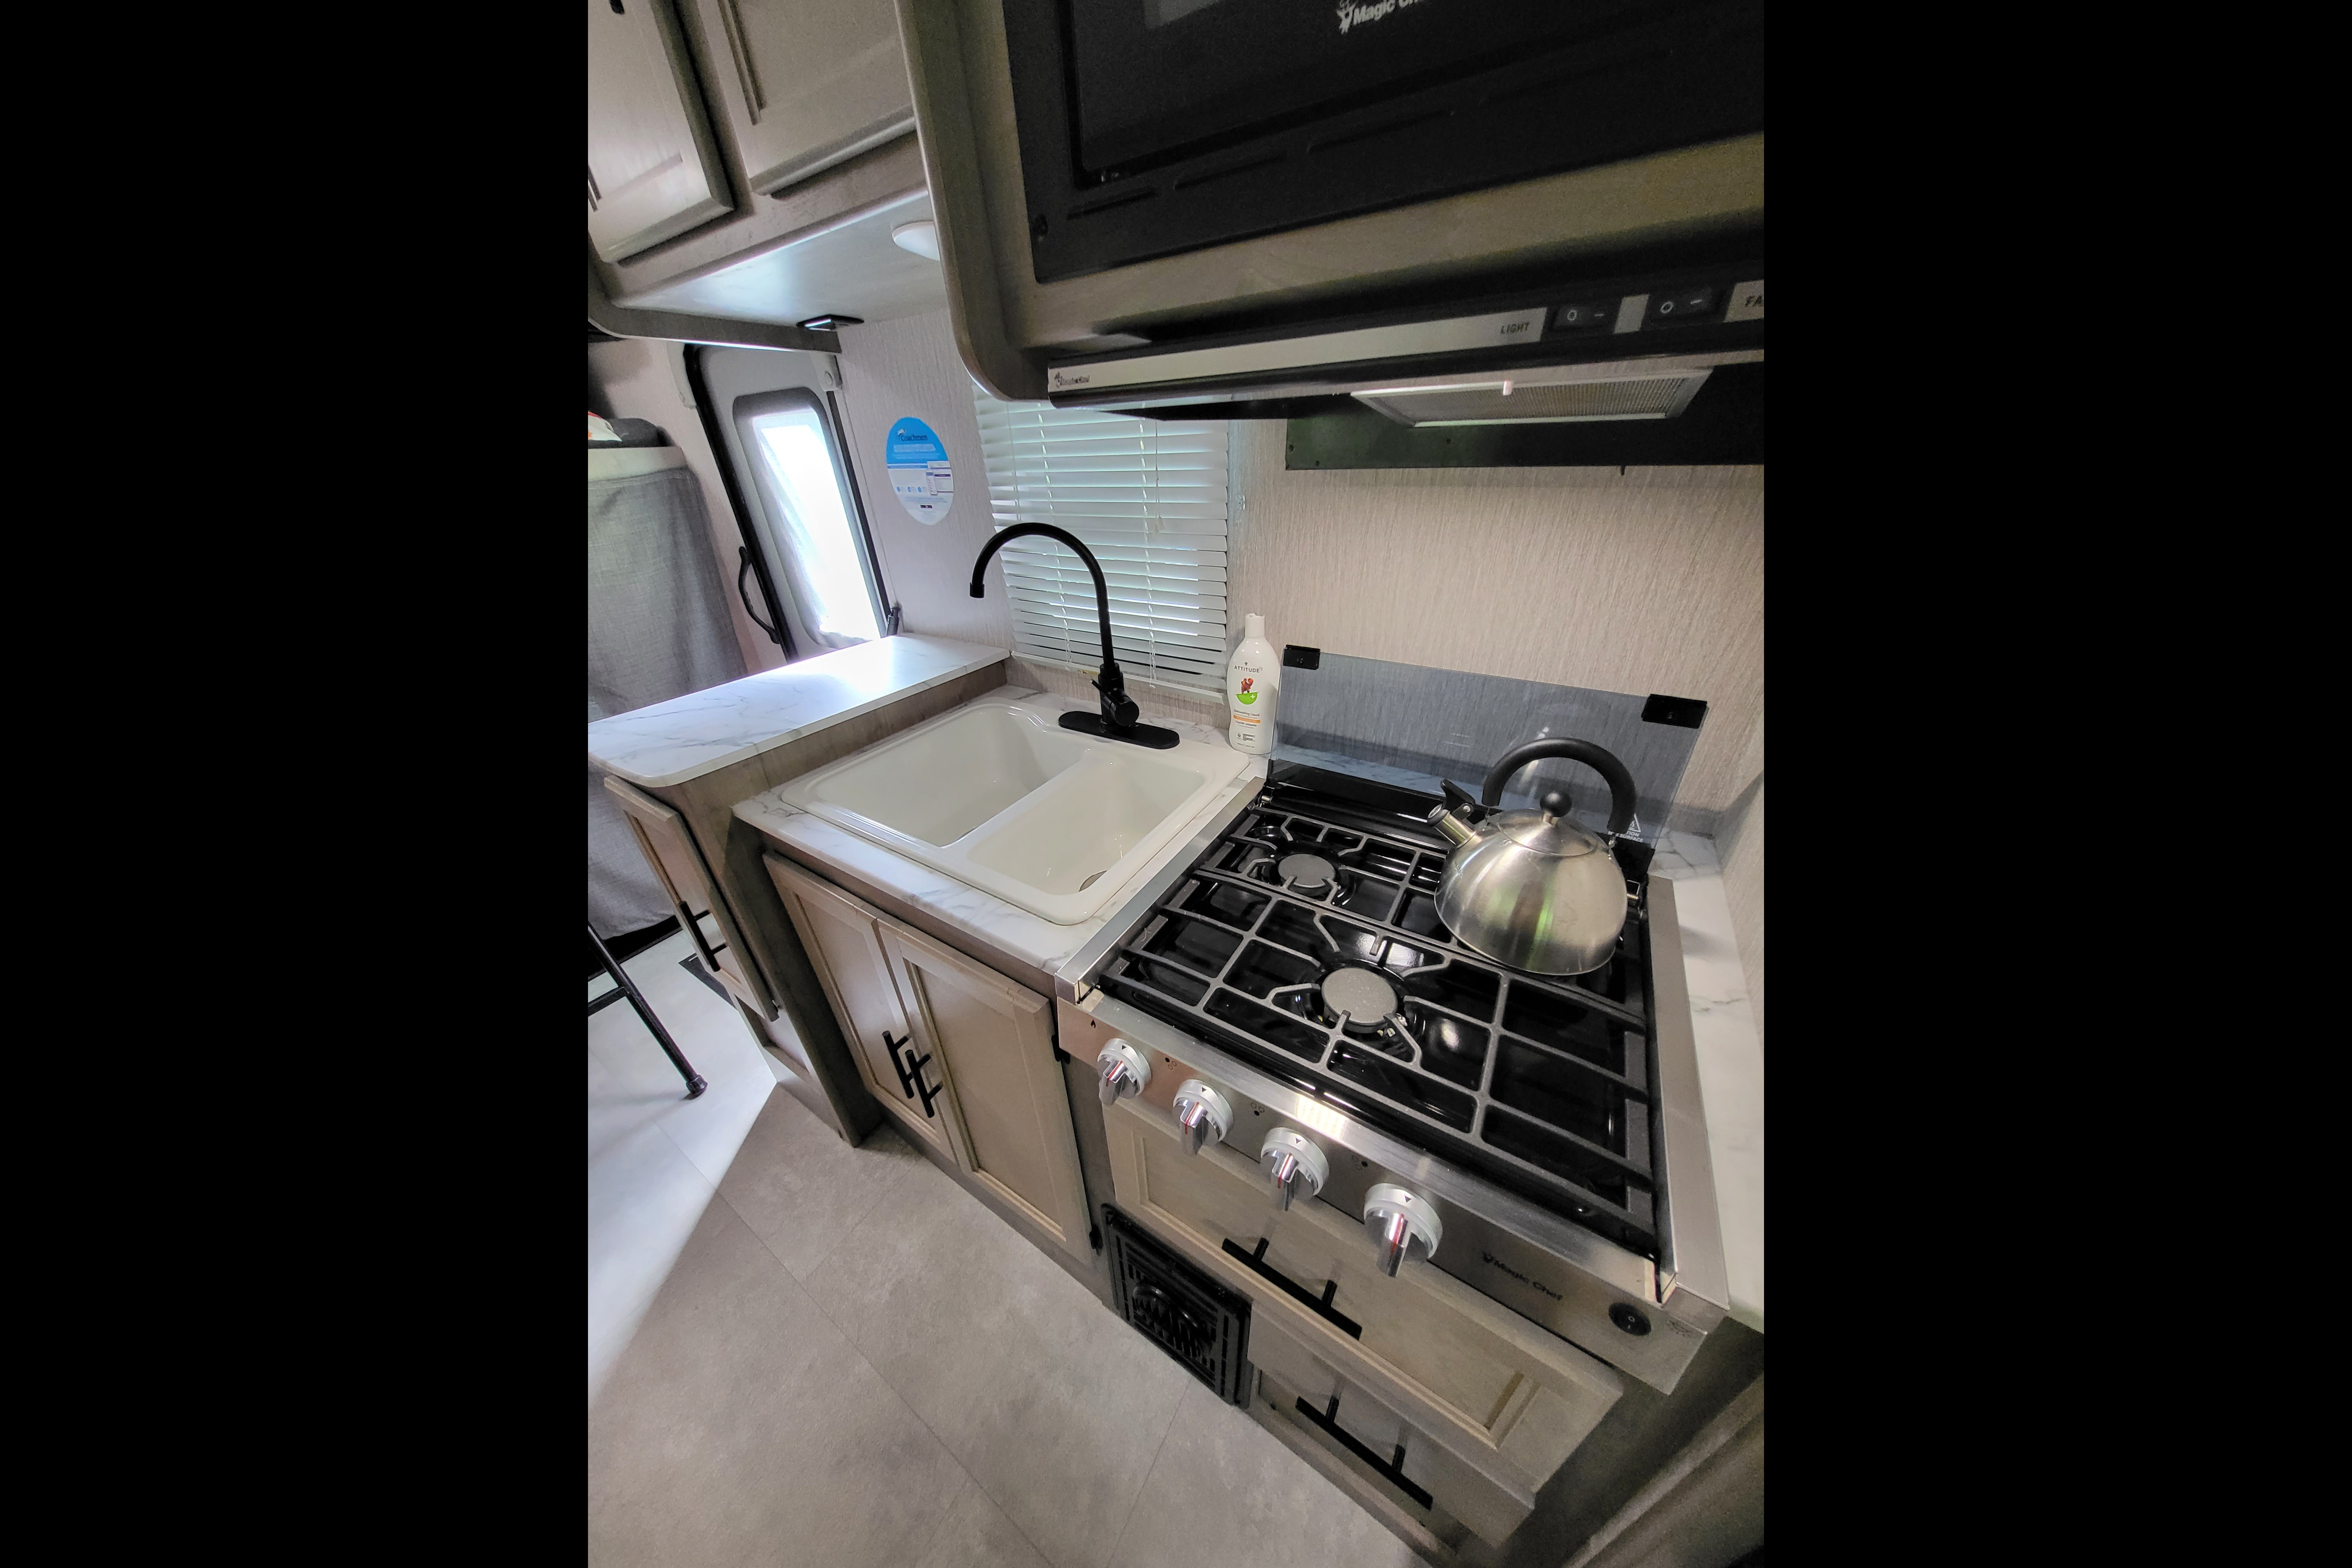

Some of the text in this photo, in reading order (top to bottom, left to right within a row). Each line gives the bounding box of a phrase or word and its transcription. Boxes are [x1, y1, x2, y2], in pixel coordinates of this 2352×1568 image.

[1353, 0, 1396, 25] Magic
[1501, 322, 1530, 334] LIGHT
[1494, 1260, 1563, 1301] Magic Chef
